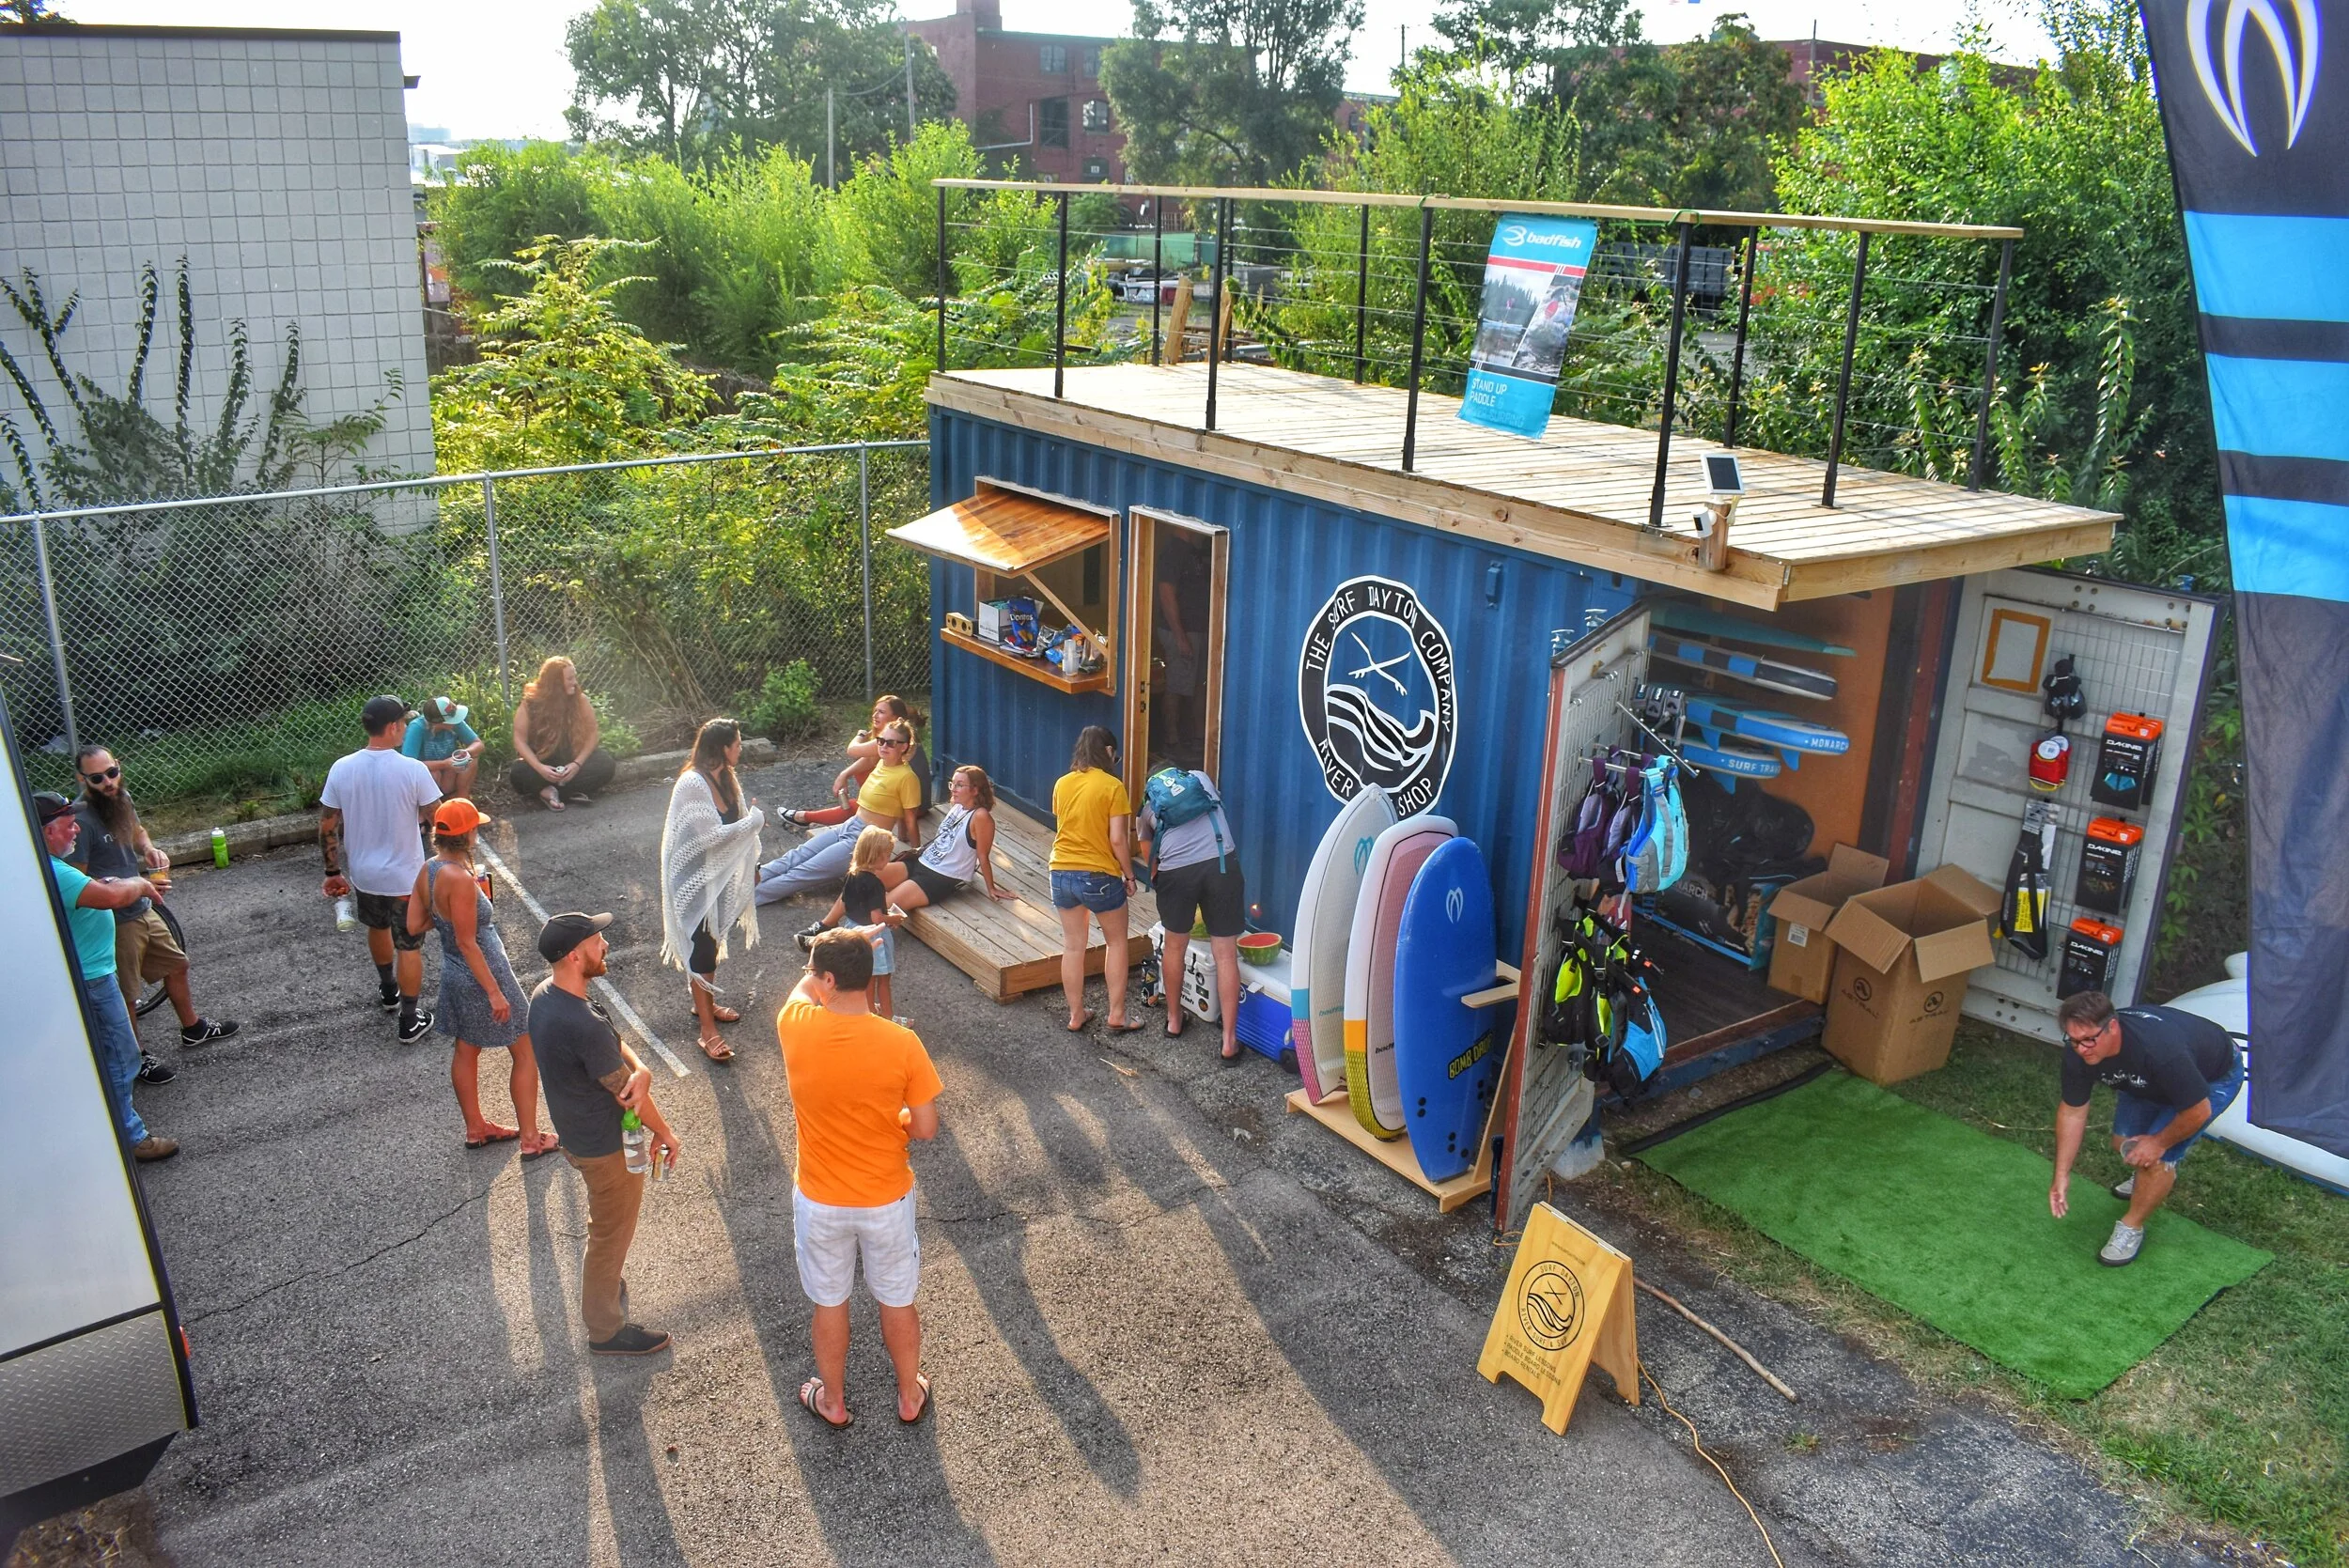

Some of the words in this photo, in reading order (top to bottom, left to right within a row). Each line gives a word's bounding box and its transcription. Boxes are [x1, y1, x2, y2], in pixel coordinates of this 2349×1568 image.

[1526, 231, 1582, 249] badfish
[1471, 378, 1494, 394] STAND
[1495, 382, 1507, 395] UP
[1469, 391, 1496, 407] PADDLE
[1306, 634, 1331, 671] THE
[1328, 590, 1357, 630] SURF
[1368, 585, 1419, 629] DAYTON
[1419, 630, 1454, 733] COMPANY
[2106, 738, 2143, 752] DAKINE
[1728, 759, 1757, 771] SURF
[1318, 738, 1354, 799] RIVER
[1398, 777, 1434, 817] SHOP
[2087, 843, 2123, 857] DAKINE
[2070, 941, 2105, 956] DAKINE
[1449, 1048, 1472, 1079] BOMB
[1540, 1265, 1556, 1273] SURF
[1560, 1268, 1579, 1297] DAYTON
[1520, 1308, 1532, 1330] RIVER
[1532, 1332, 1547, 1345] SURF
